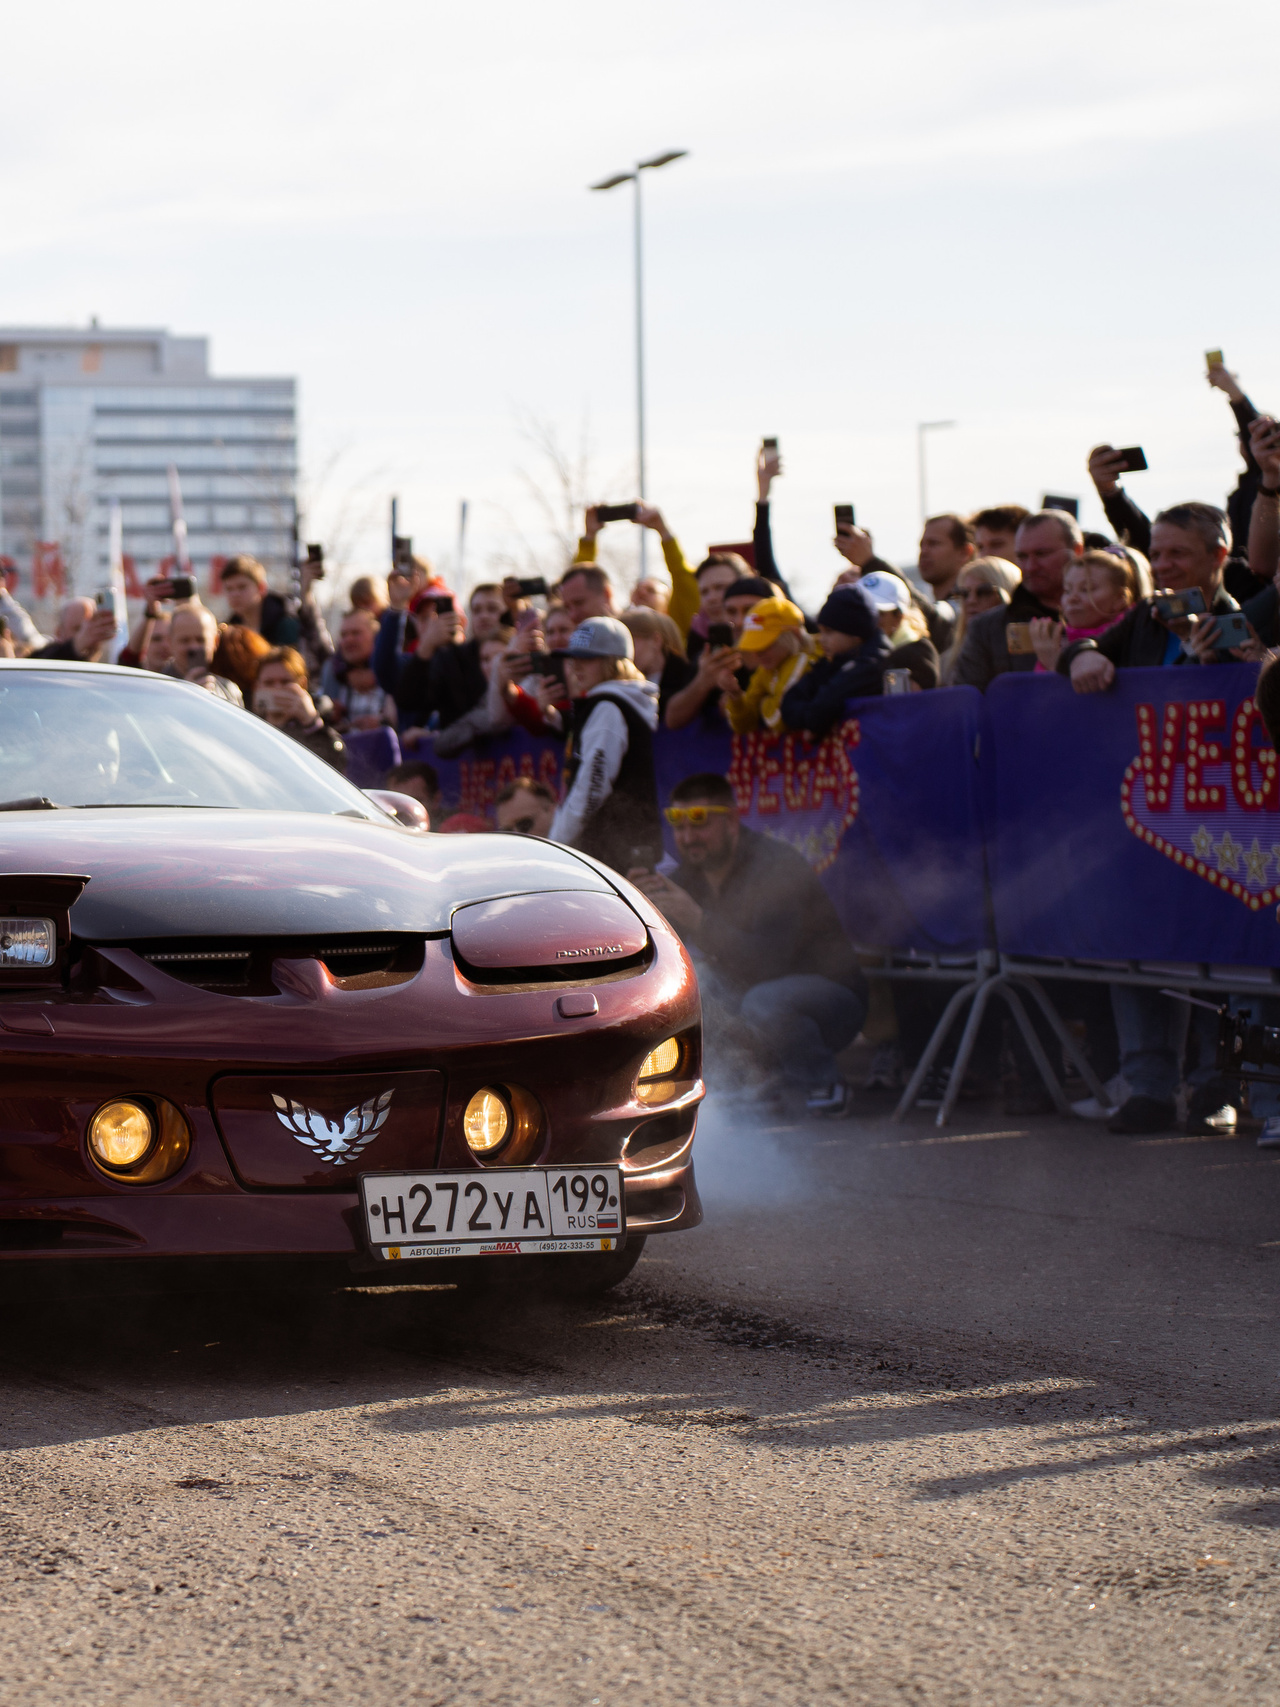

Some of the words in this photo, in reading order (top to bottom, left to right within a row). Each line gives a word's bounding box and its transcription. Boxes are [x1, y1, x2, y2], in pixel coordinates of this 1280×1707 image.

[555, 944, 623, 959] PONTIAC
[381, 1181, 545, 1234] Н272УА
[552, 1174, 609, 1212] 199
[567, 1215, 596, 1229] RUS
[409, 1246, 461, 1257] АВТОЦЕНТР
[538, 1242, 558, 1251] (495)
[558, 1241, 595, 1250] 22-333-55
